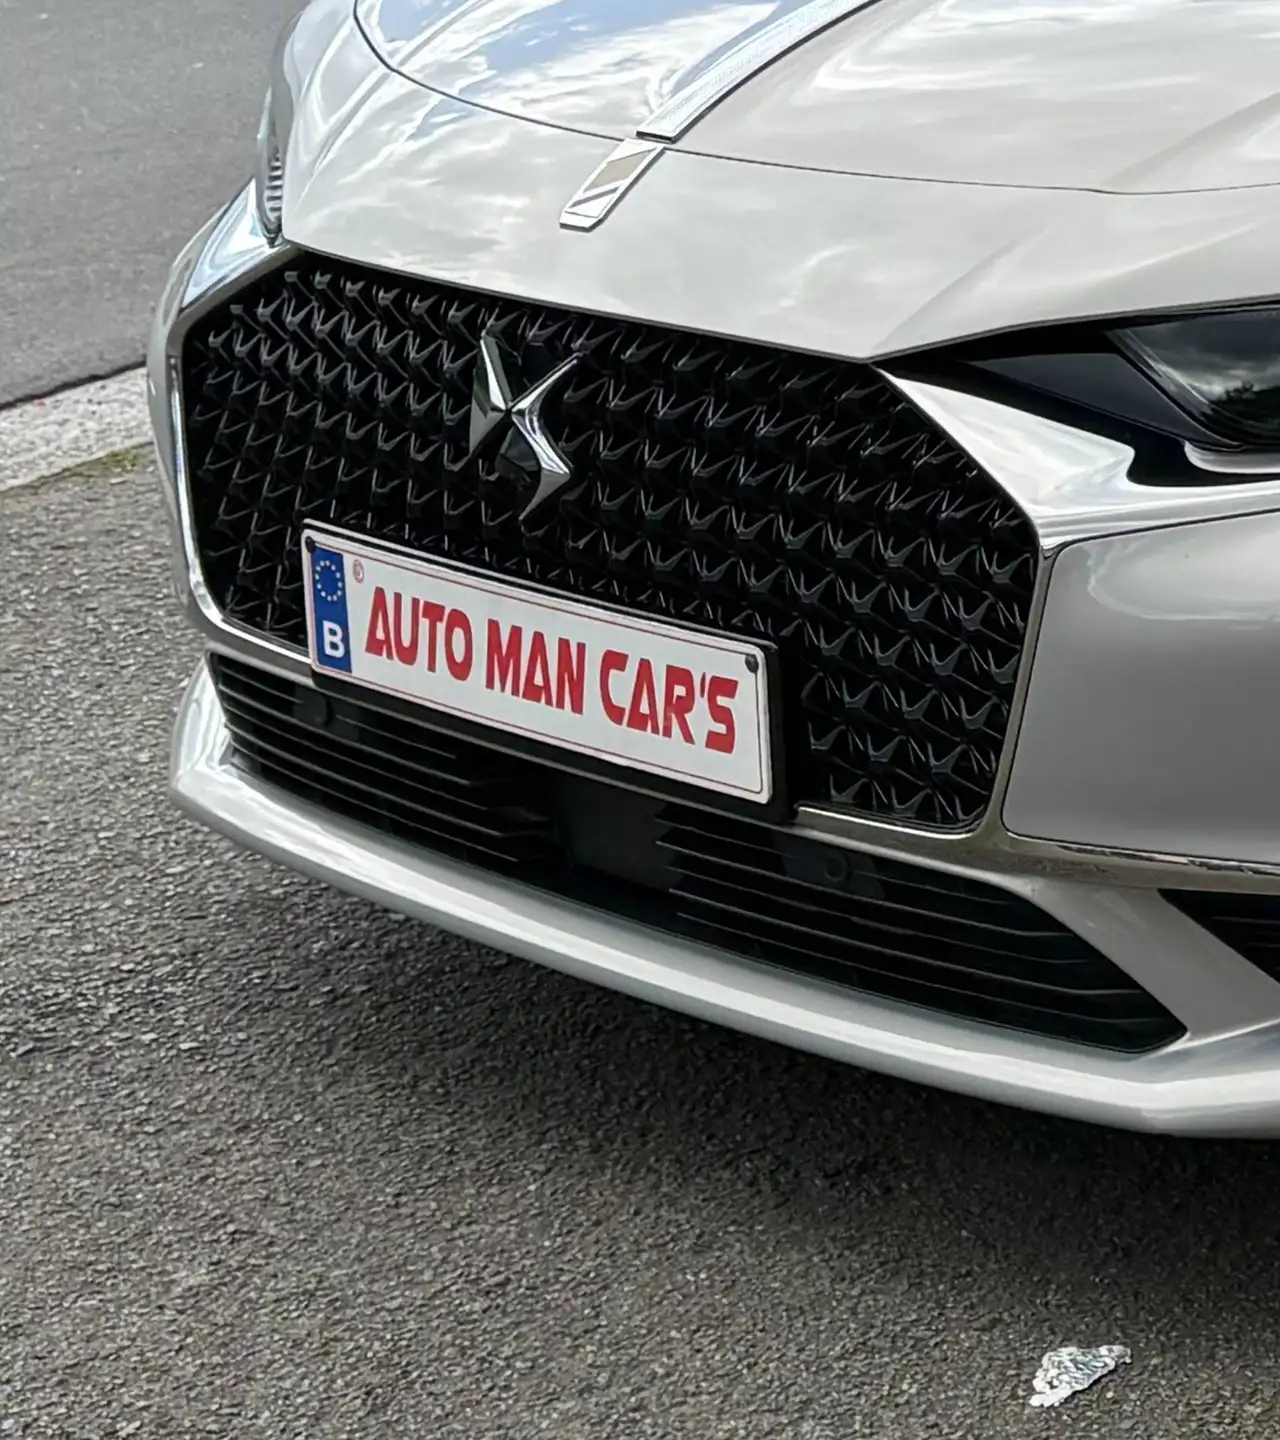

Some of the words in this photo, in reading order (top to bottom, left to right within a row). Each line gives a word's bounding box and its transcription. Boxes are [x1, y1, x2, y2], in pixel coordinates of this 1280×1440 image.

[321, 620, 346, 660] B
[365, 584, 474, 683] AUTO
[485, 618, 587, 717] MAN
[599, 648, 740, 755] CAR'S
